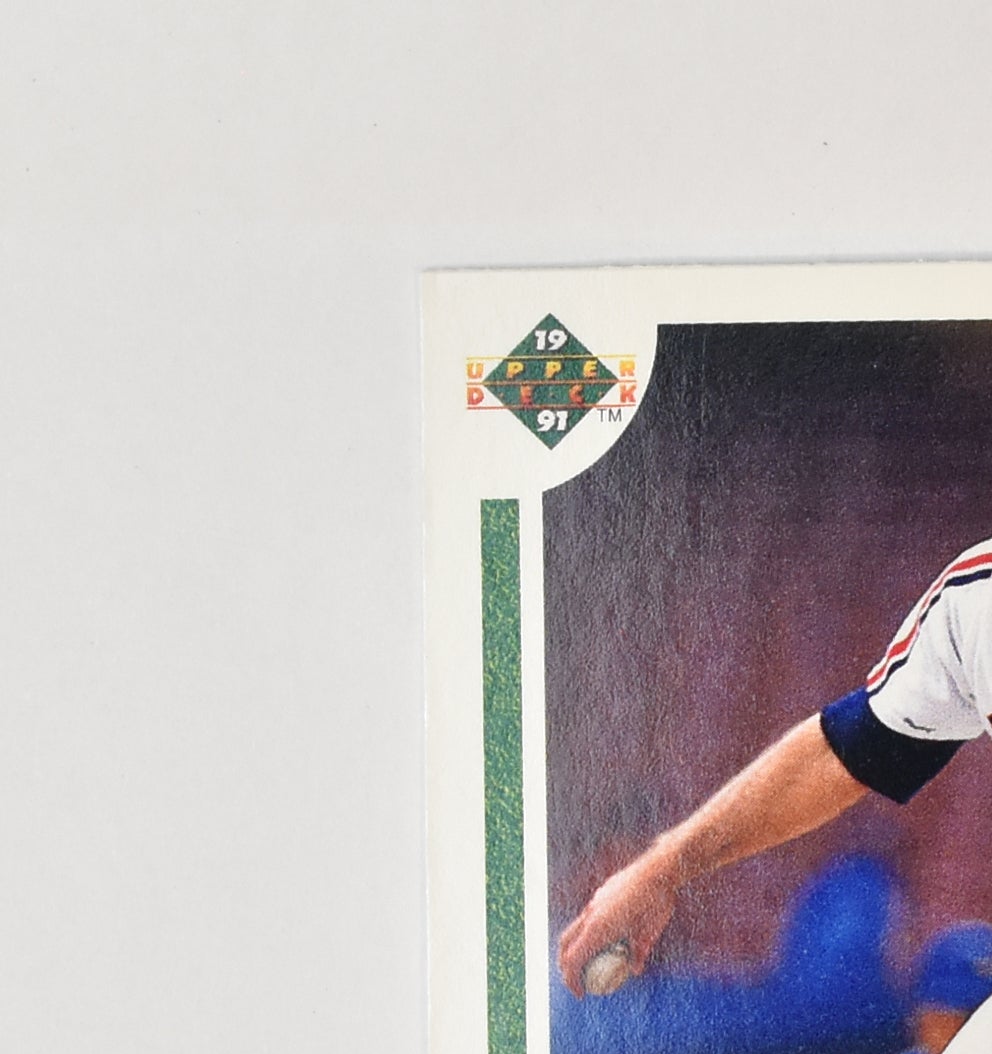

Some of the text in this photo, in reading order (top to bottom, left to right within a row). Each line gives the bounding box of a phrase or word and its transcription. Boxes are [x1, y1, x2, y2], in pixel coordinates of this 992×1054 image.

[534, 329, 568, 351] 19
[466, 360, 636, 379] UPPER
[466, 384, 637, 406] DECK
[537, 409, 569, 432] 91
[597, 408, 622, 423] TM
